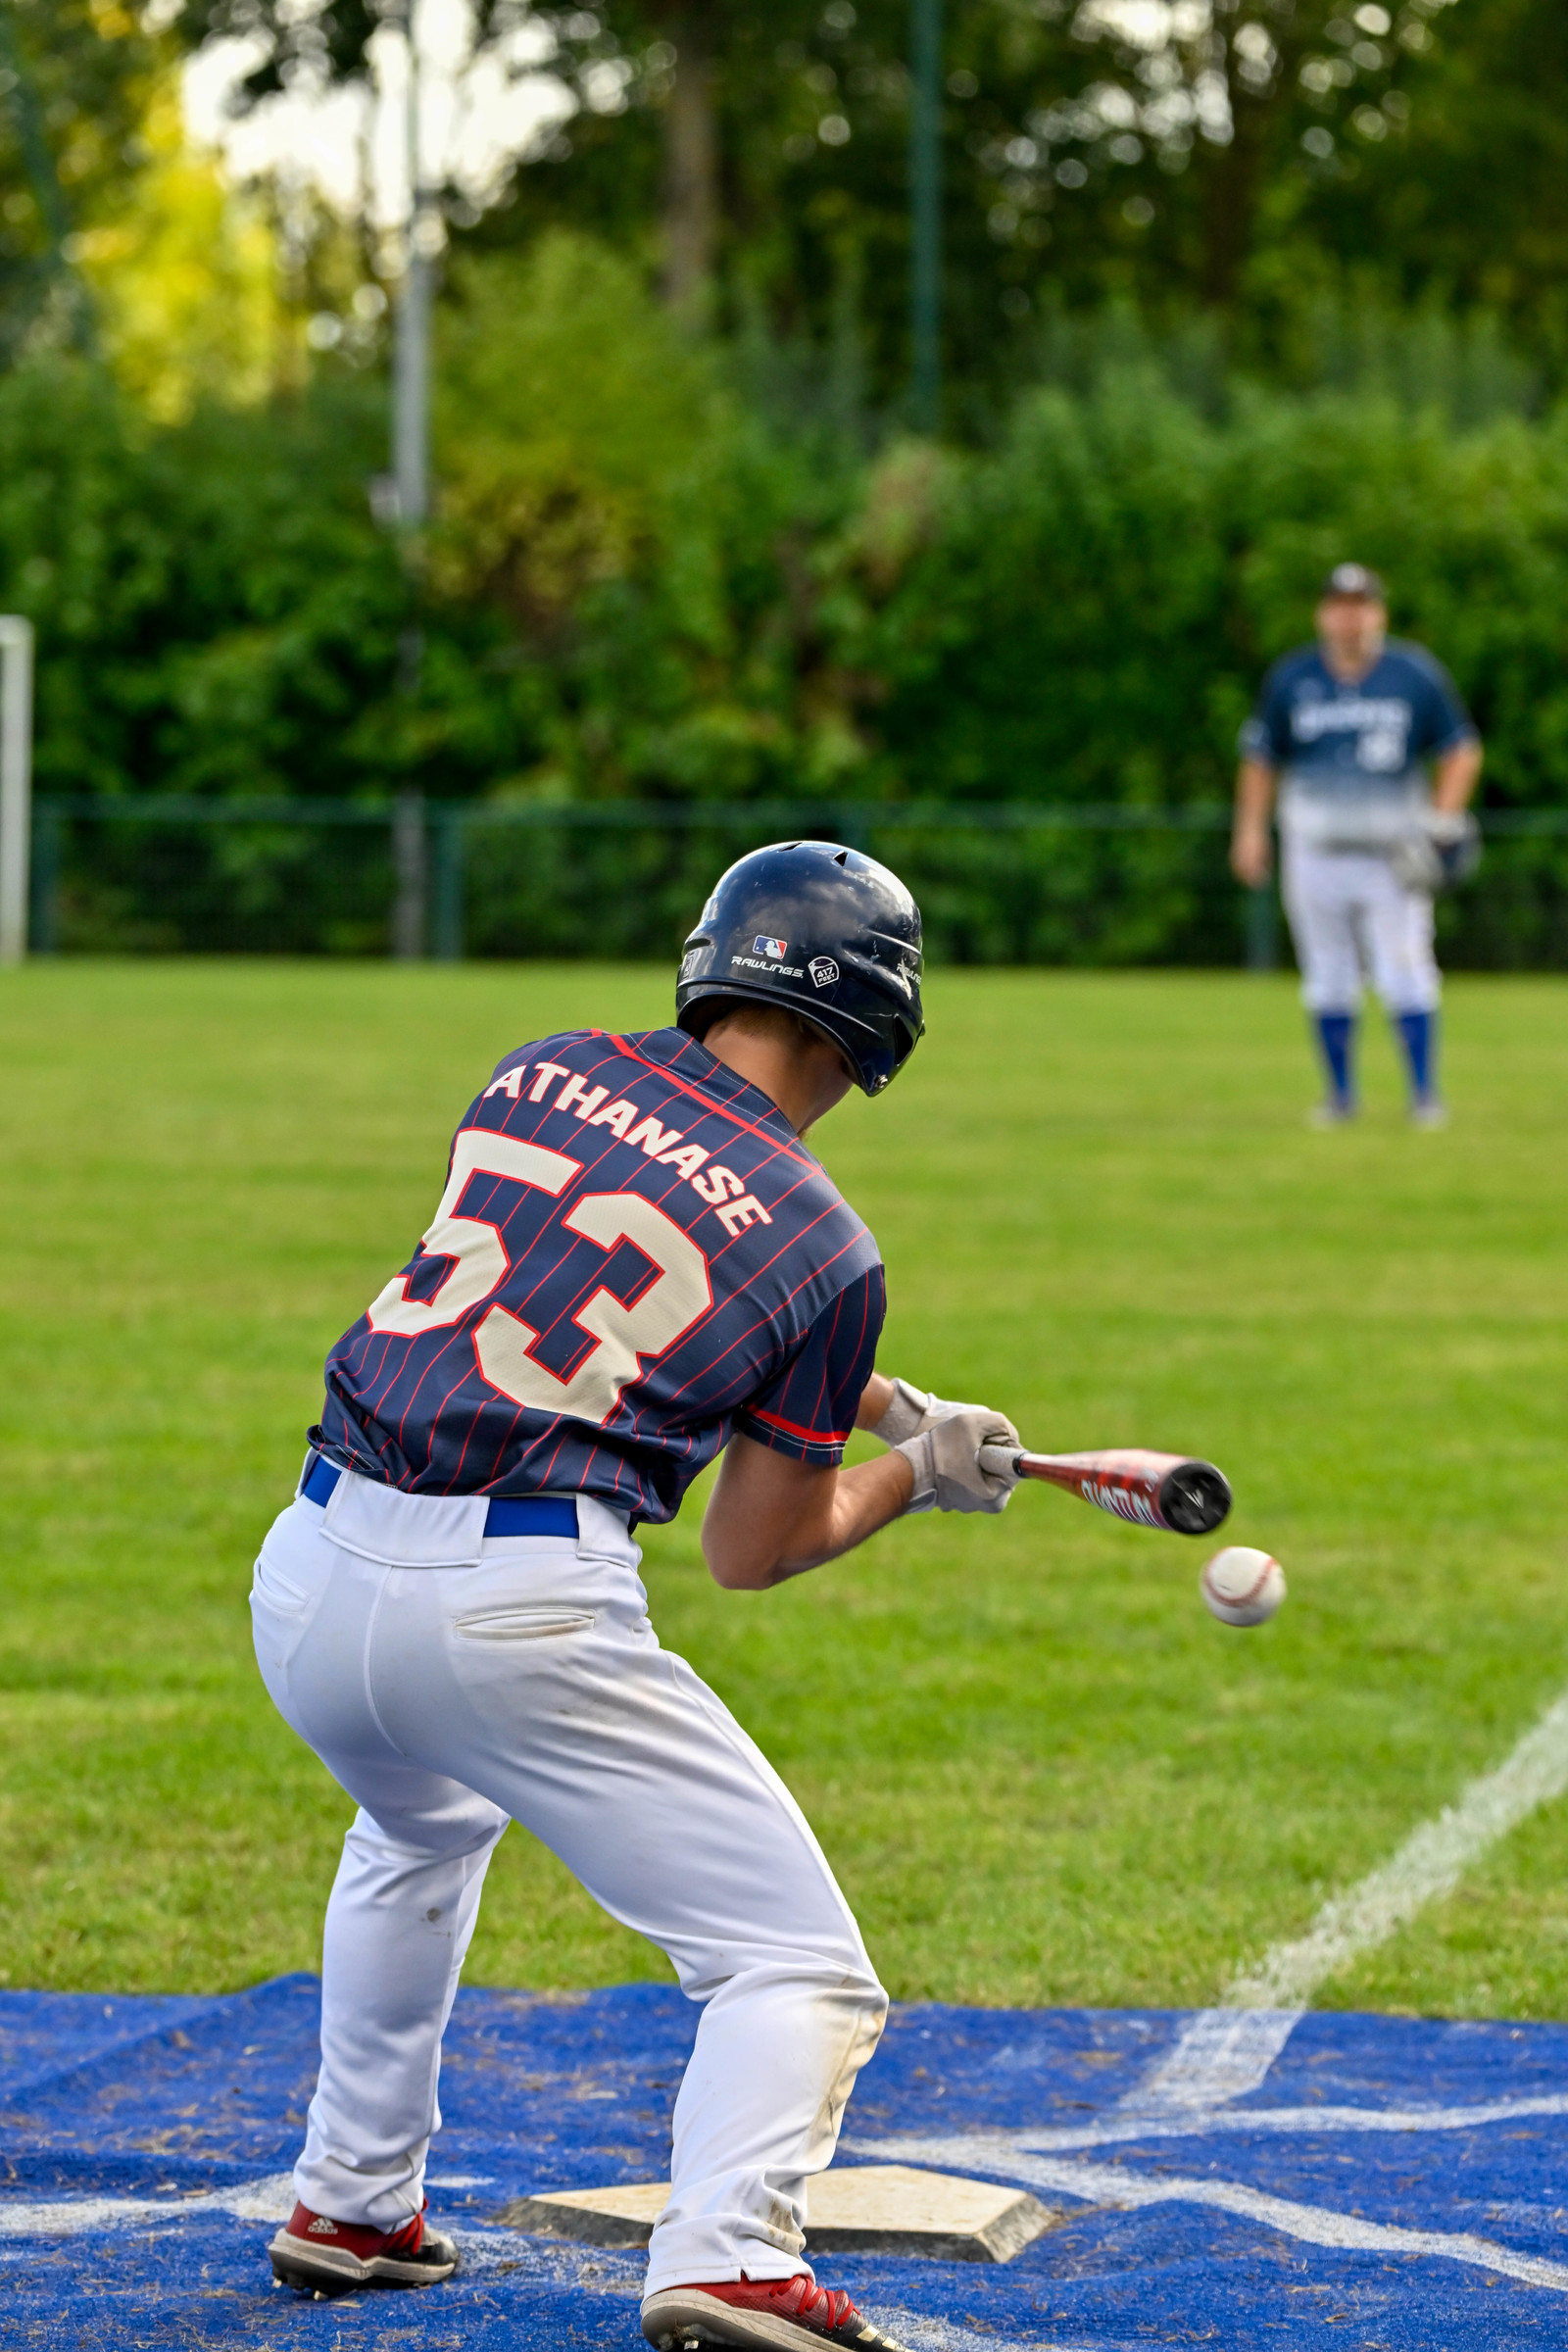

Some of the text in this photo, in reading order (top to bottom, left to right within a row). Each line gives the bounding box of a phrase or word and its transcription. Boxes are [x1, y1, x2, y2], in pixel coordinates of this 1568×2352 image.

[731, 956, 804, 978] RAWLINGS
[816, 966, 833, 978] 417
[482, 1061, 773, 1237] ATHANASE
[367, 1126, 714, 1425] 53
[308, 2226, 338, 2234] adidas
